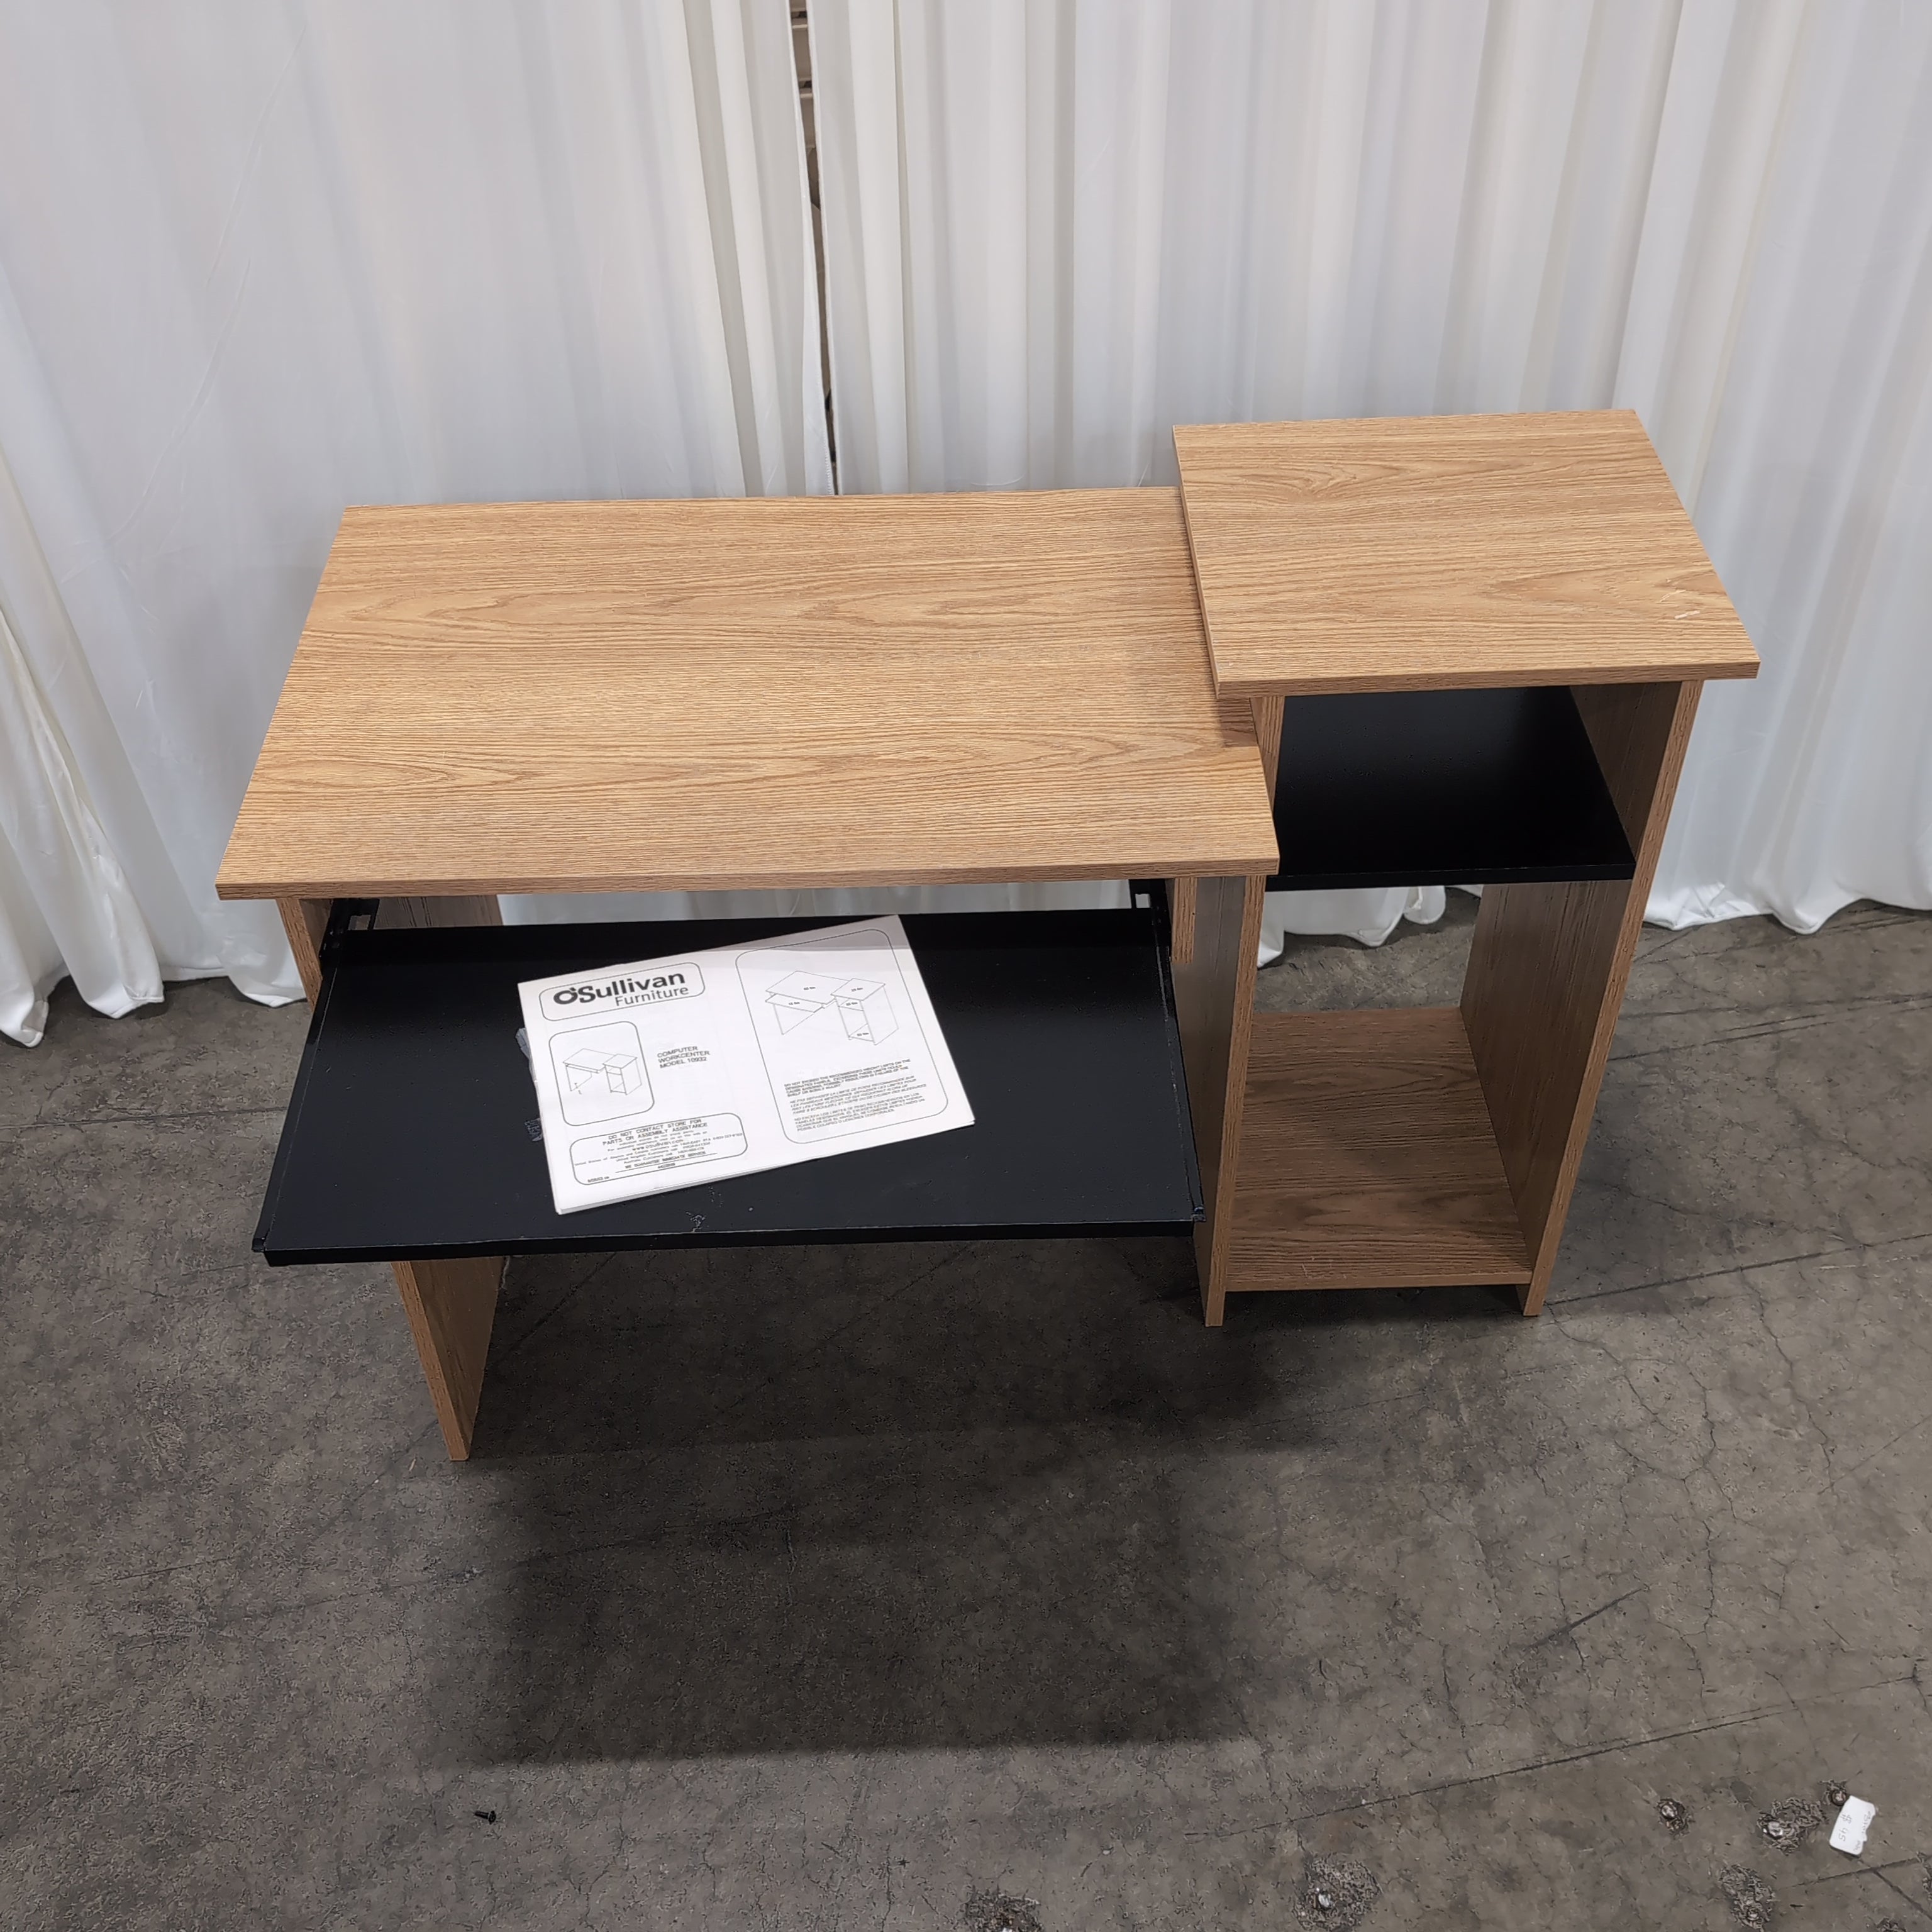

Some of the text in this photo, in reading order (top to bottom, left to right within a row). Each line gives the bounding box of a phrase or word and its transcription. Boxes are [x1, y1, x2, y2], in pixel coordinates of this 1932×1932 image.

[553, 973, 686, 1005] O'Sullivan
[615, 986, 689, 1006] Furniture
[657, 1046, 698, 1057] COMPUTER
[658, 1050, 710, 1063] WORKCENTER
[660, 1058, 686, 1068] MODEL
[636, 1124, 663, 1133] CONTACT
